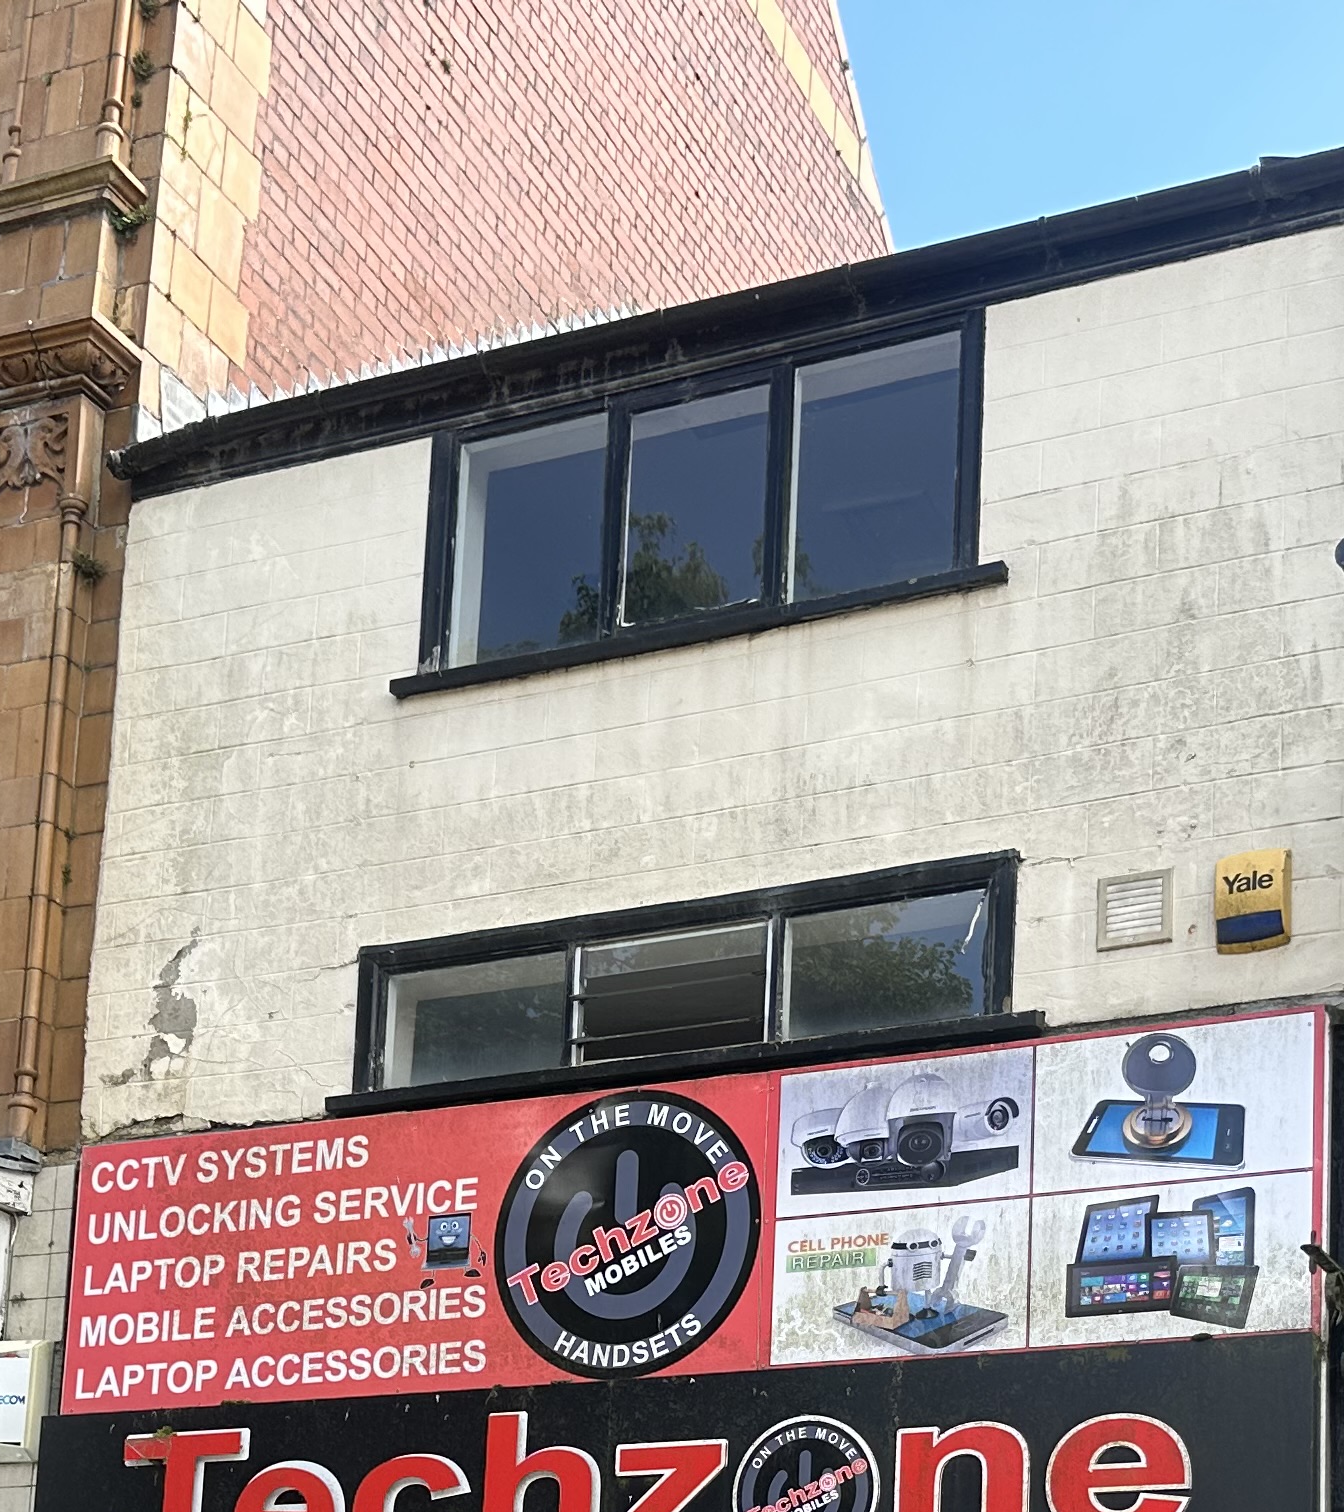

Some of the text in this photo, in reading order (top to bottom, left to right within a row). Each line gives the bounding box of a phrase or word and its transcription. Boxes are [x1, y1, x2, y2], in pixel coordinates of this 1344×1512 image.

[1222, 870, 1274, 895] Yale
[92, 1135, 370, 1194] CCTV SYSTEMS
[525, 1103, 730, 1190] ON THE MOVE
[88, 1177, 479, 1246] UNLOCKING SERVICE
[507, 1159, 750, 1306] Techzone
[83, 1237, 397, 1297] LAPTOP REPAIRS
[584, 1225, 692, 1297] MOBILES
[787, 1232, 889, 1254] CELL PHONE
[792, 1251, 864, 1270] REPAIR
[79, 1284, 487, 1348] MOBILE ACCESSORIES
[553, 1312, 702, 1369] HANDSETS
[74, 1339, 487, 1400] LAPTOP ACCESSORIES
[752, 1427, 857, 1470] ON THE MOVE
